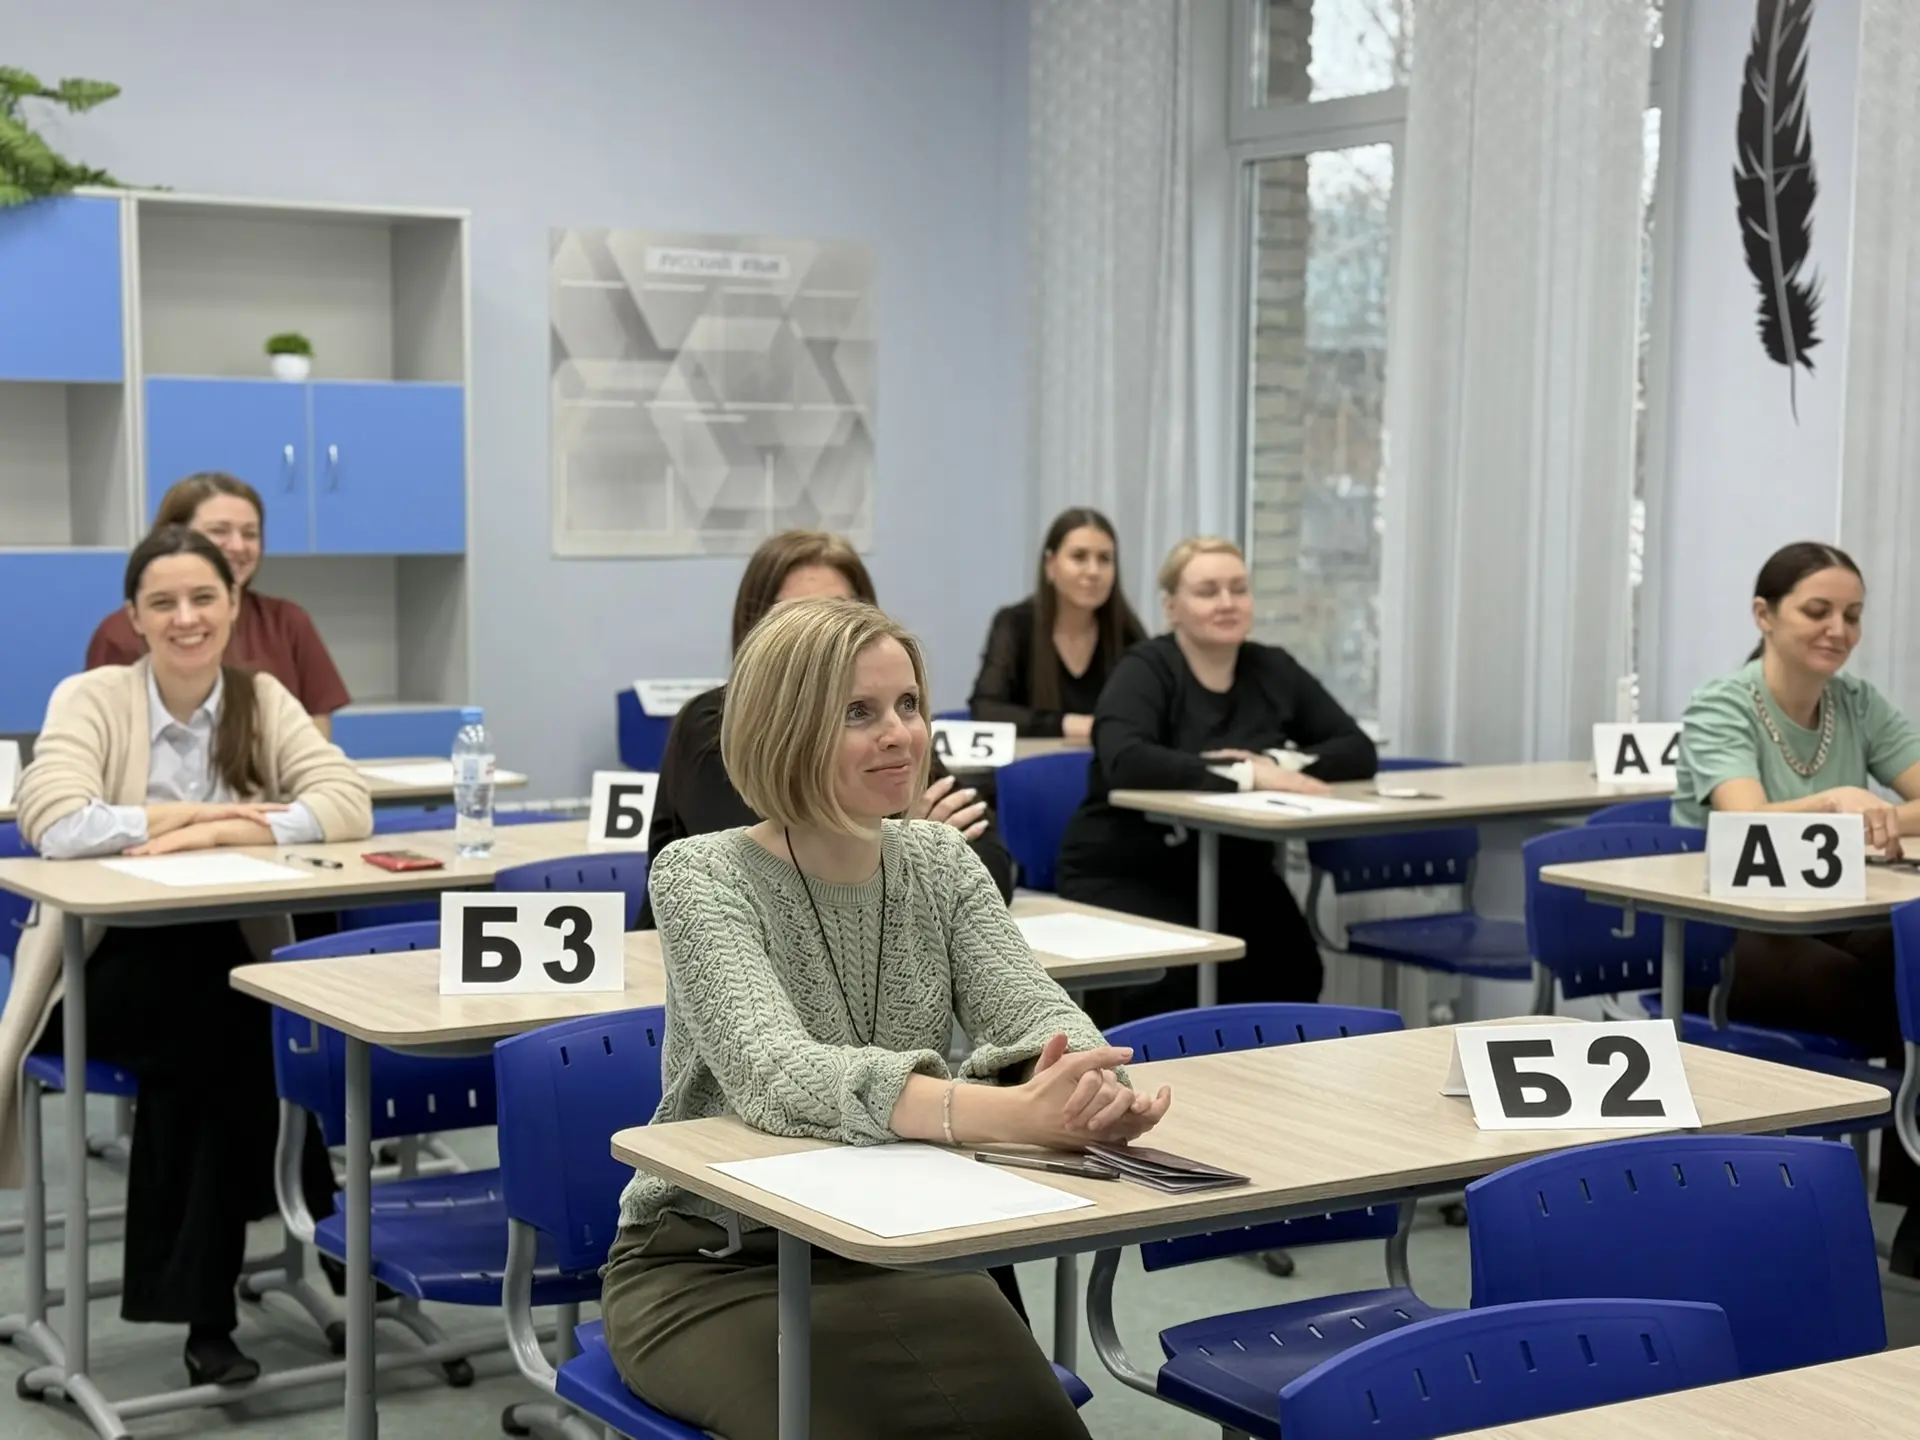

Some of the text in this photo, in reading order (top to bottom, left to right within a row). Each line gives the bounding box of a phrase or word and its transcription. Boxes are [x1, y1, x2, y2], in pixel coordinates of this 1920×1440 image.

[970, 731, 993, 758] 5
[1614, 733, 1650, 774] А
[604, 784, 644, 838] Б
[1732, 823, 1843, 889] А 3
[461, 905, 596, 984] Б 3
[1486, 1035, 1667, 1118] Б 2
